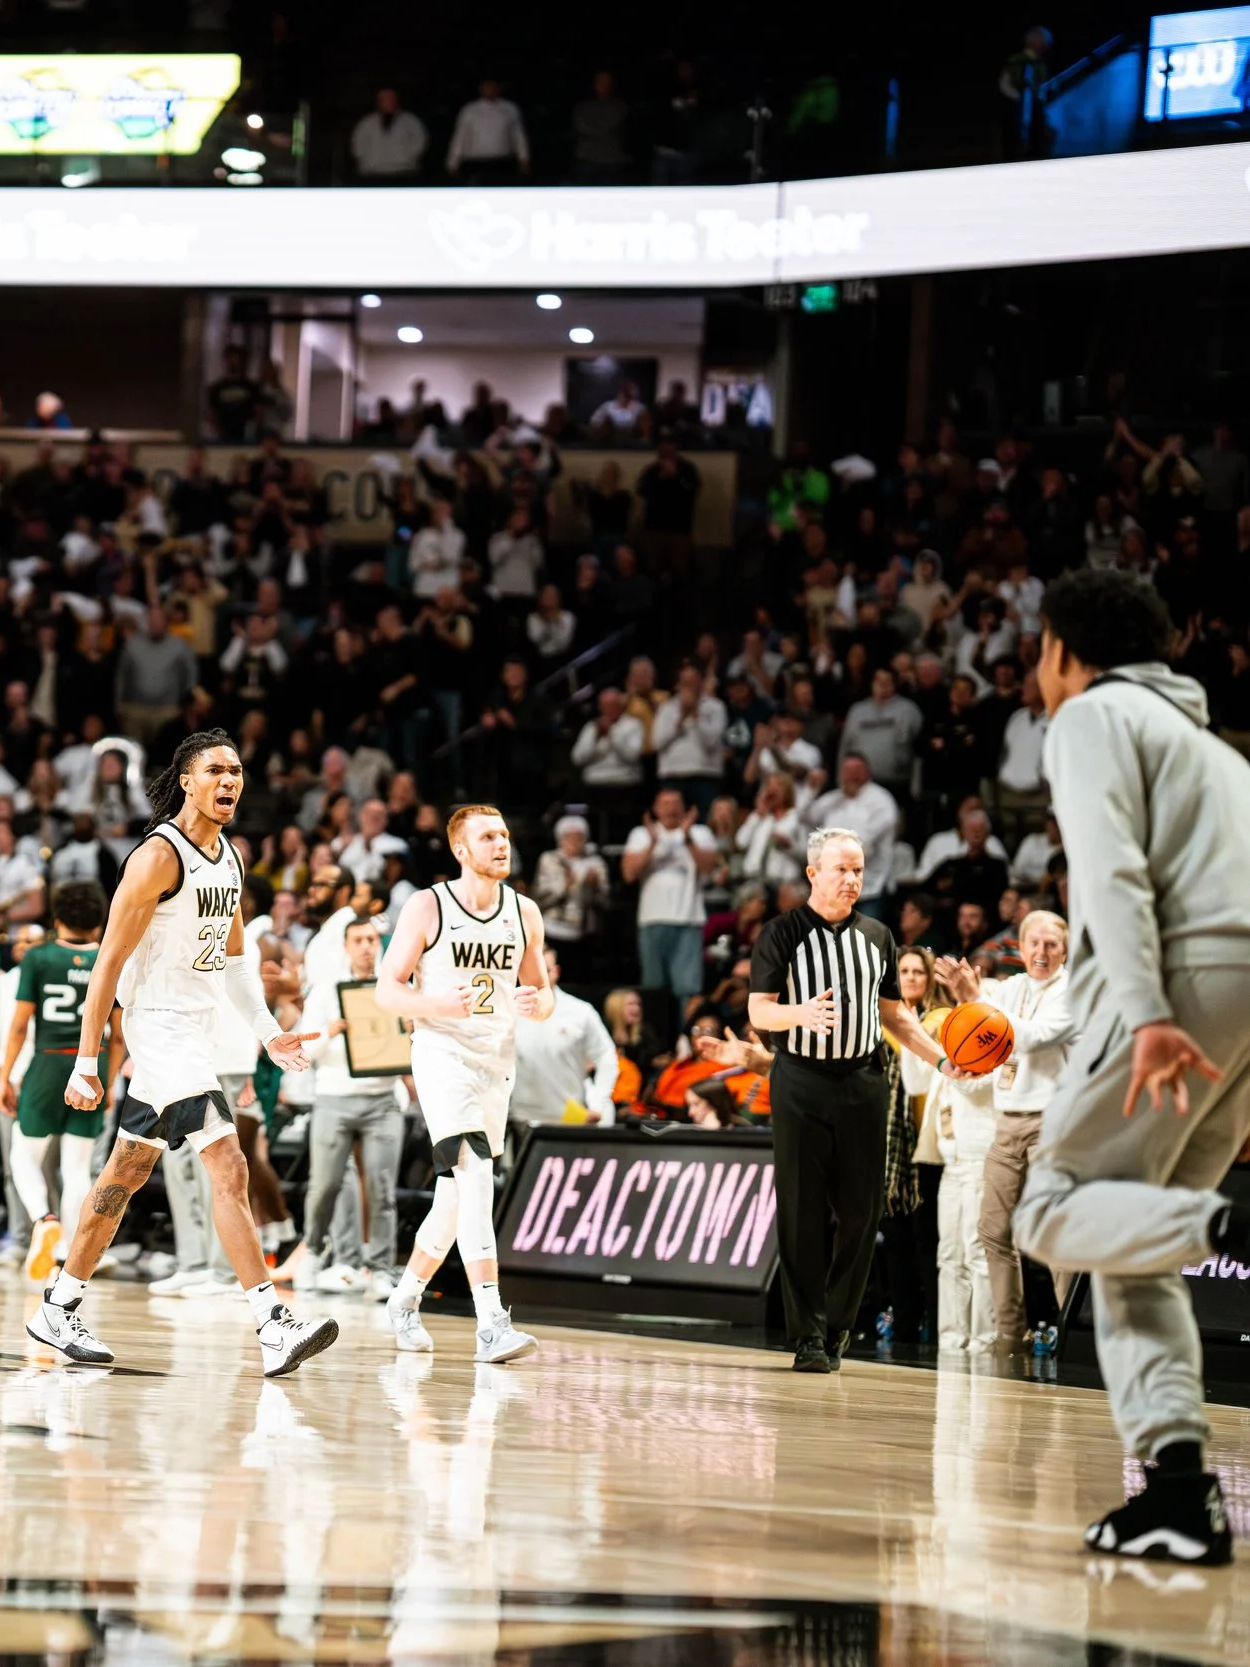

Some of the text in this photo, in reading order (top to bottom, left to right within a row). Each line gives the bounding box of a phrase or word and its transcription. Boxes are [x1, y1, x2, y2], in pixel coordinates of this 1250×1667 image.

[530, 205, 870, 263] Harris Teeter
[196, 887, 238, 917] WAKE
[192, 924, 226, 971] 23
[452, 942, 515, 970] WAKE
[43, 983, 85, 1022] 2
[472, 973, 494, 1014] 2
[512, 1156, 777, 1267] DEACTOWN
